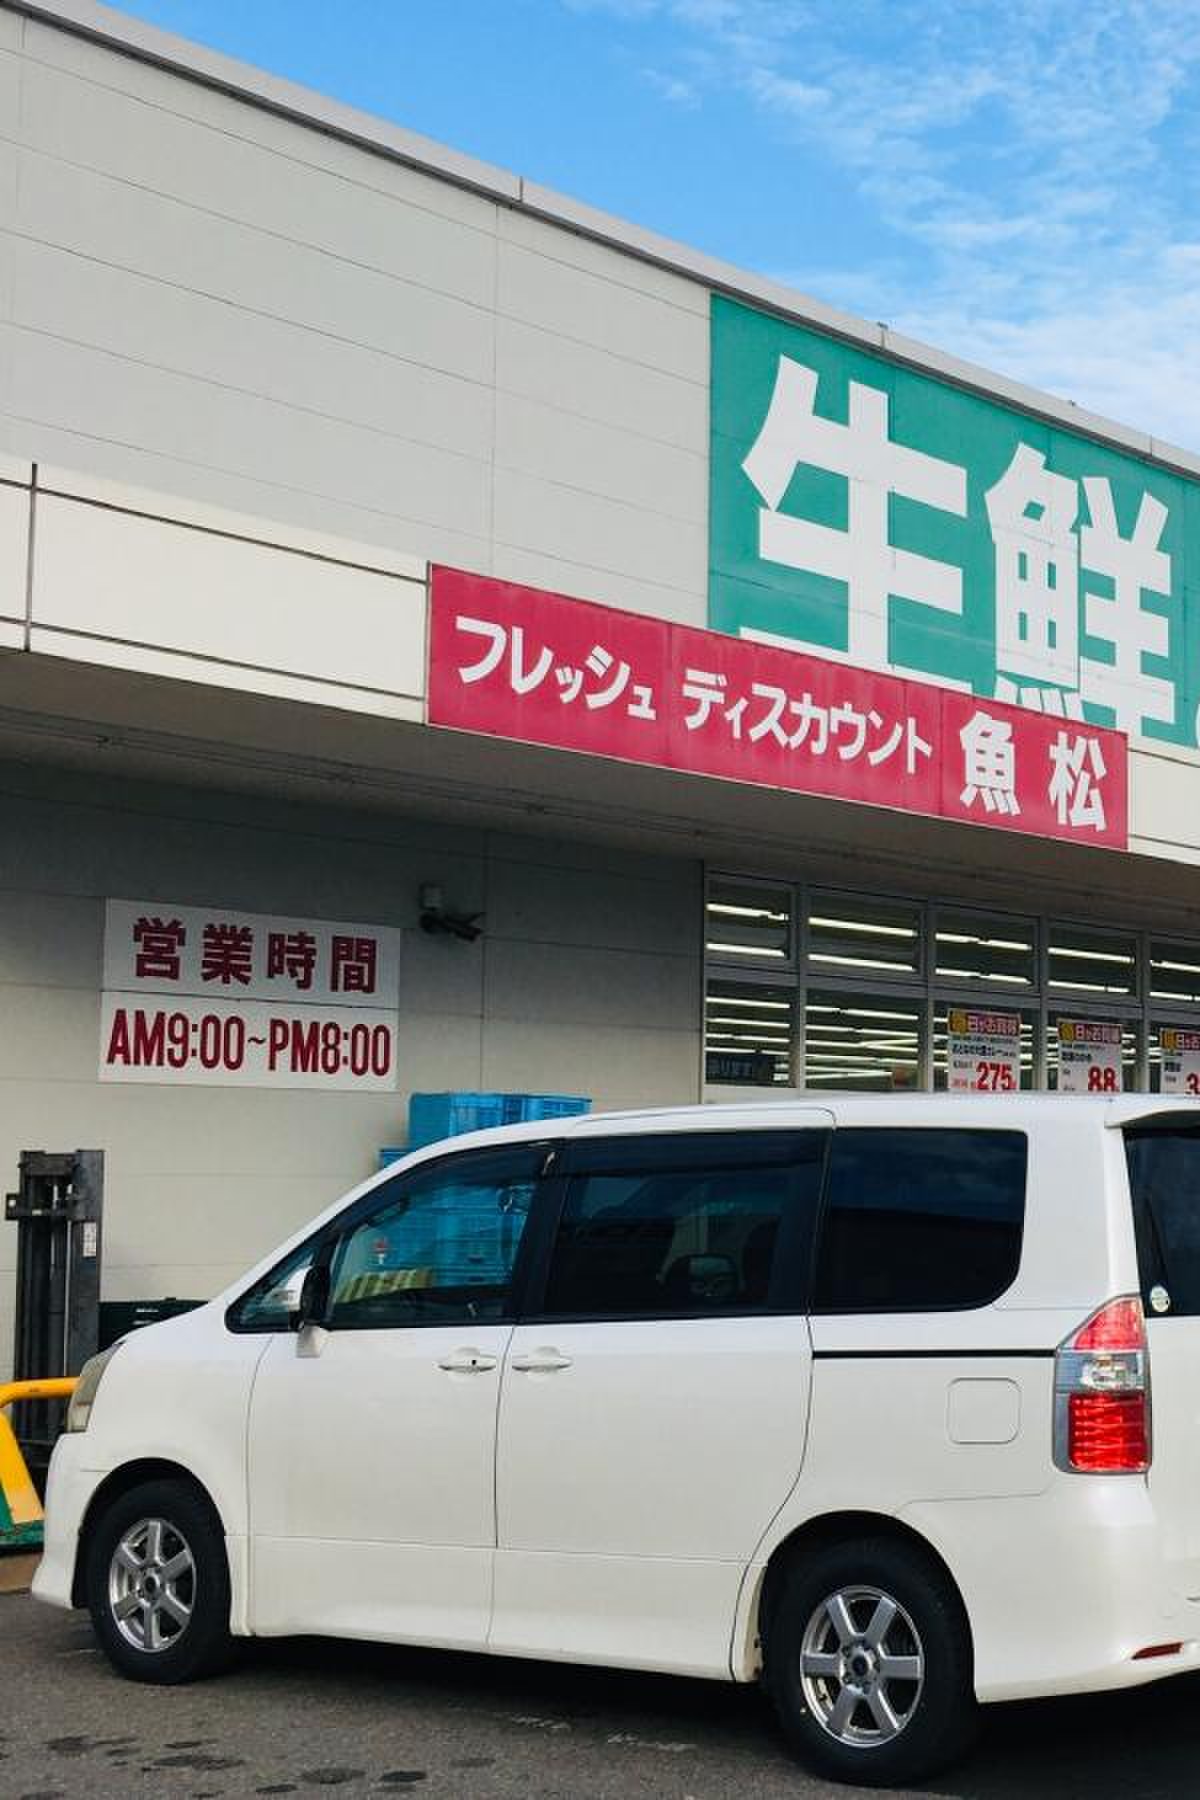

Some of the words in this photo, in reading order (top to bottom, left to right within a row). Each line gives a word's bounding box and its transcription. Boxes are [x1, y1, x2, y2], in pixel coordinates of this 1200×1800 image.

[454, 614, 657, 721] フレッシュ
[682, 668, 933, 775] ディスカウント
[959, 710, 1108, 832] 魚松
[132, 916, 378, 993] 営業時間
[975, 1060, 1013, 1091] 275
[1087, 1065, 1115, 1092] 88
